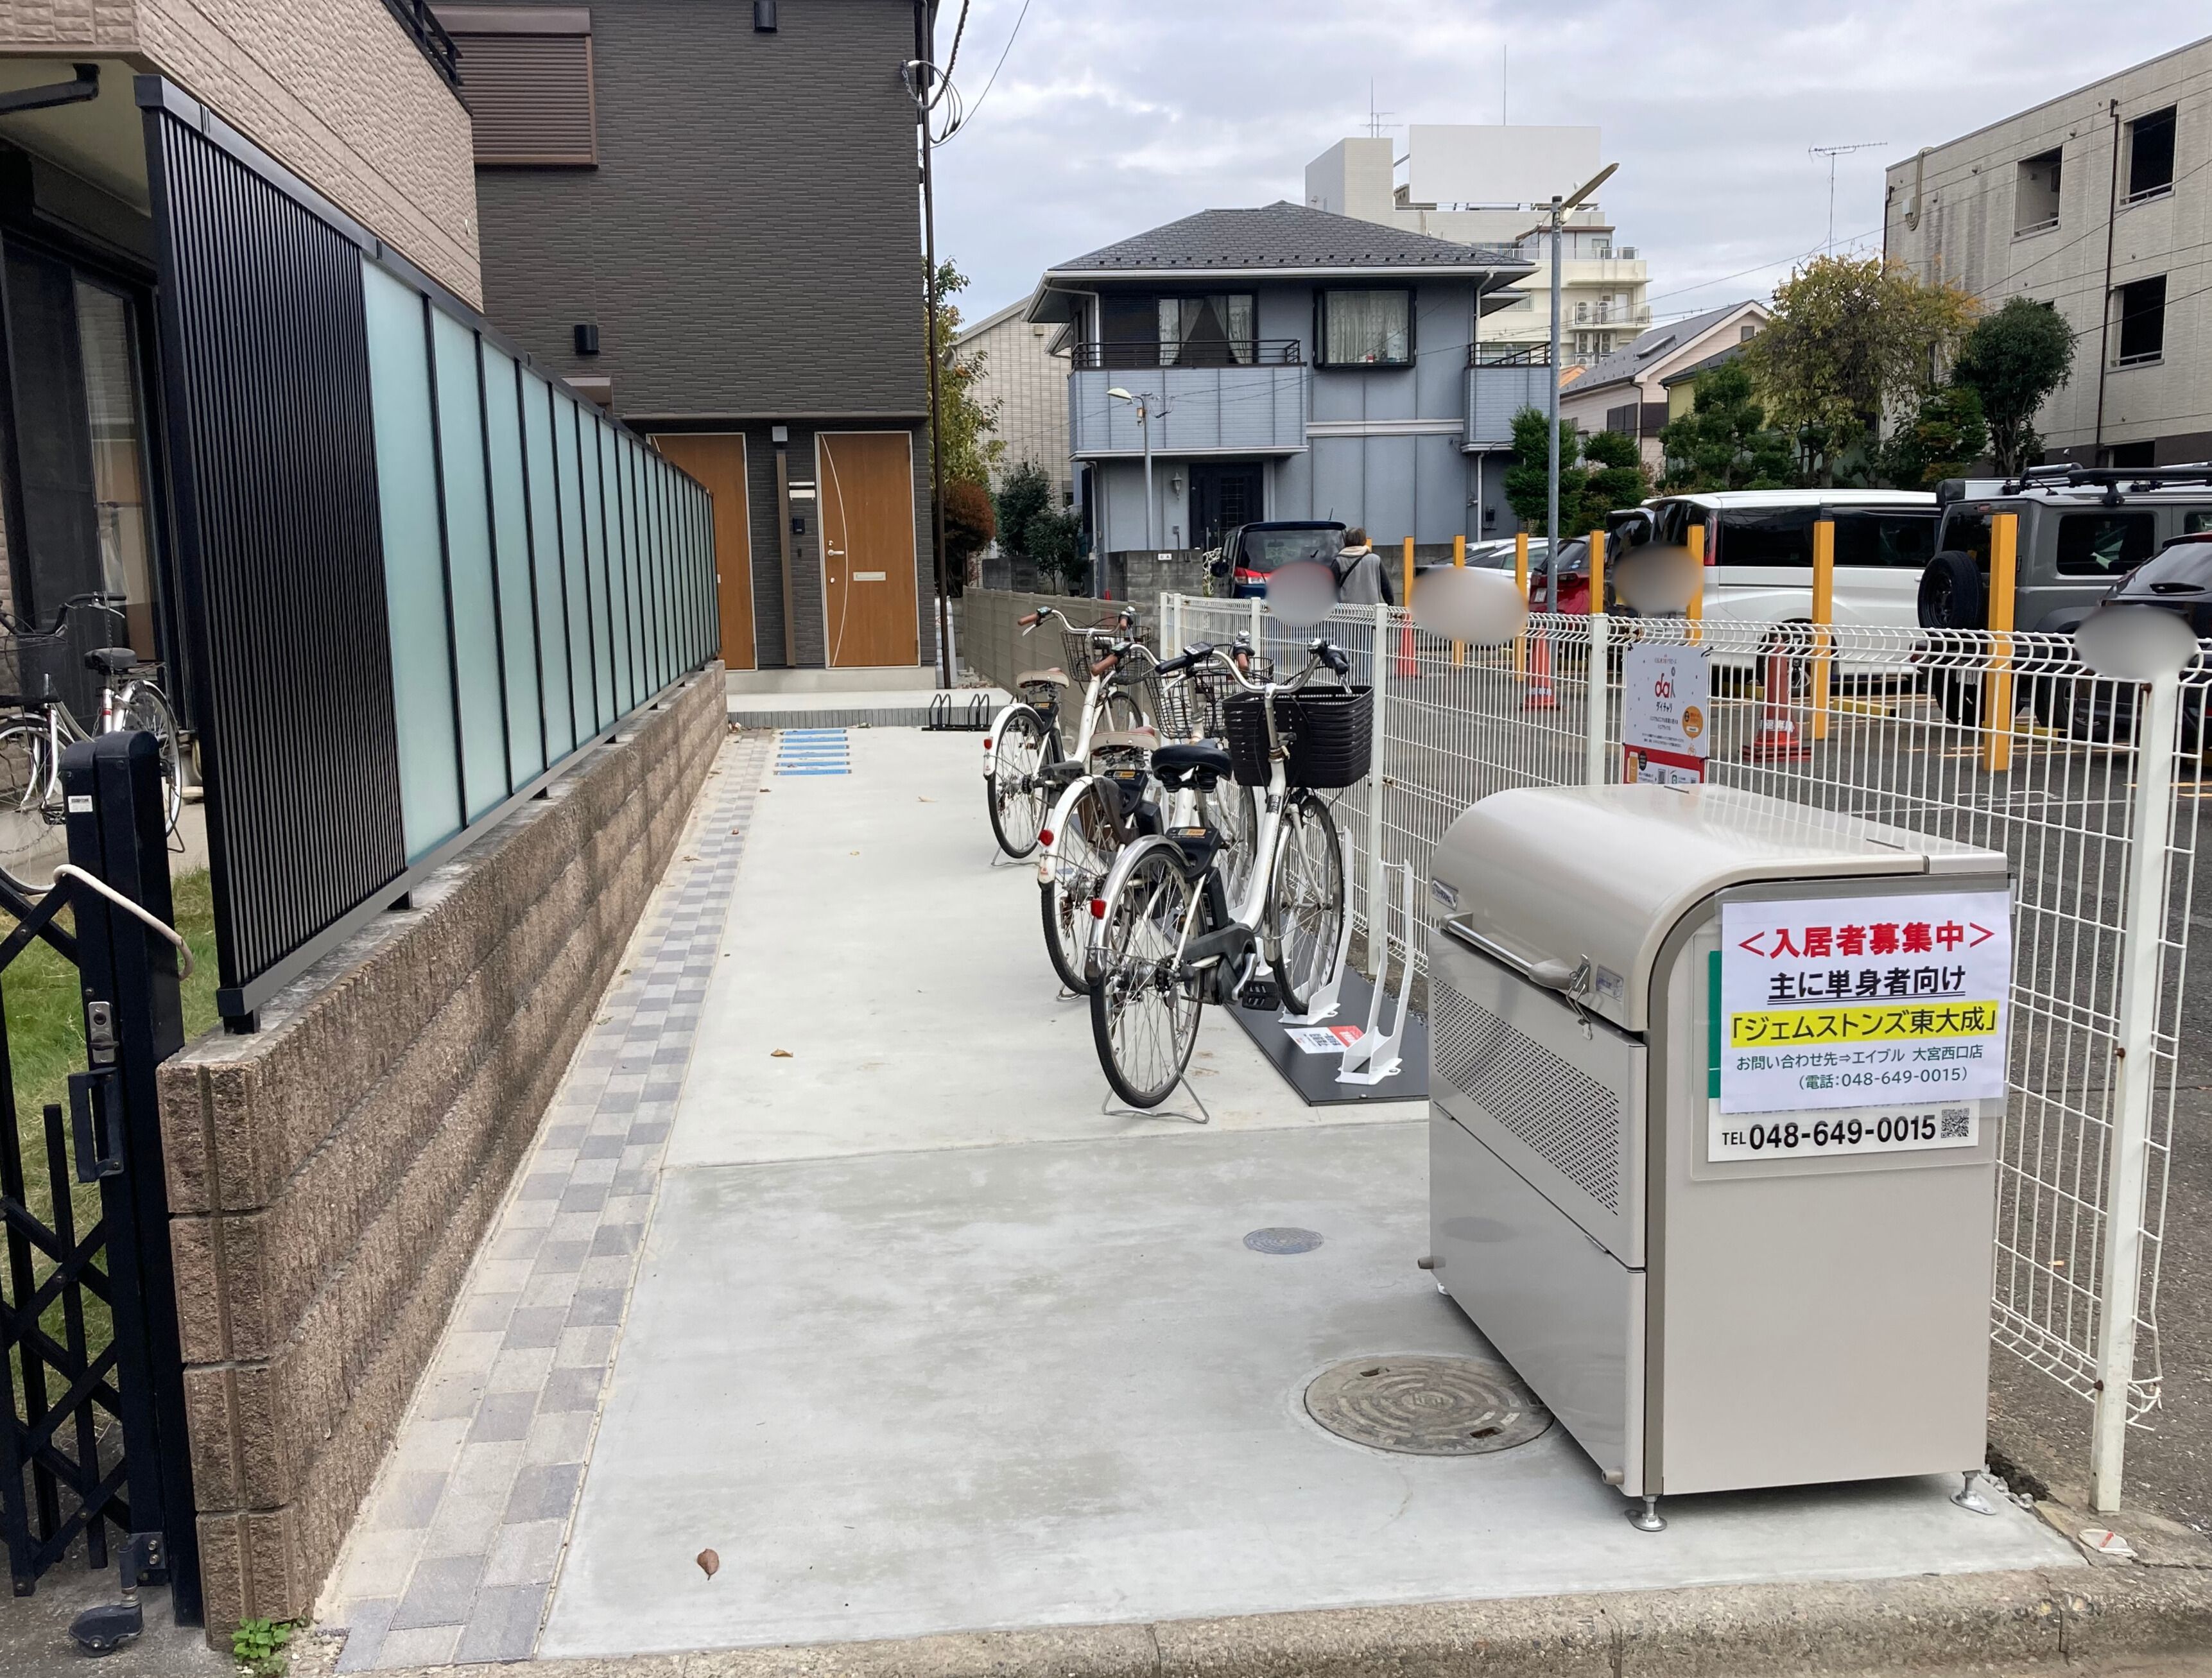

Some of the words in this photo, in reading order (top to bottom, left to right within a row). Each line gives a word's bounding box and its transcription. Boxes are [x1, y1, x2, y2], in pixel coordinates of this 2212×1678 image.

[1768, 965, 1966, 999] 主に単身者向け
[1733, 1006, 1996, 1042] 「ジェムストンズ東大成」
[1912, 1044, 1984, 1062] 大宮西口店
[1722, 1132, 1747, 1146] TEL
[1749, 1114, 1936, 1150] 048-649-0015
